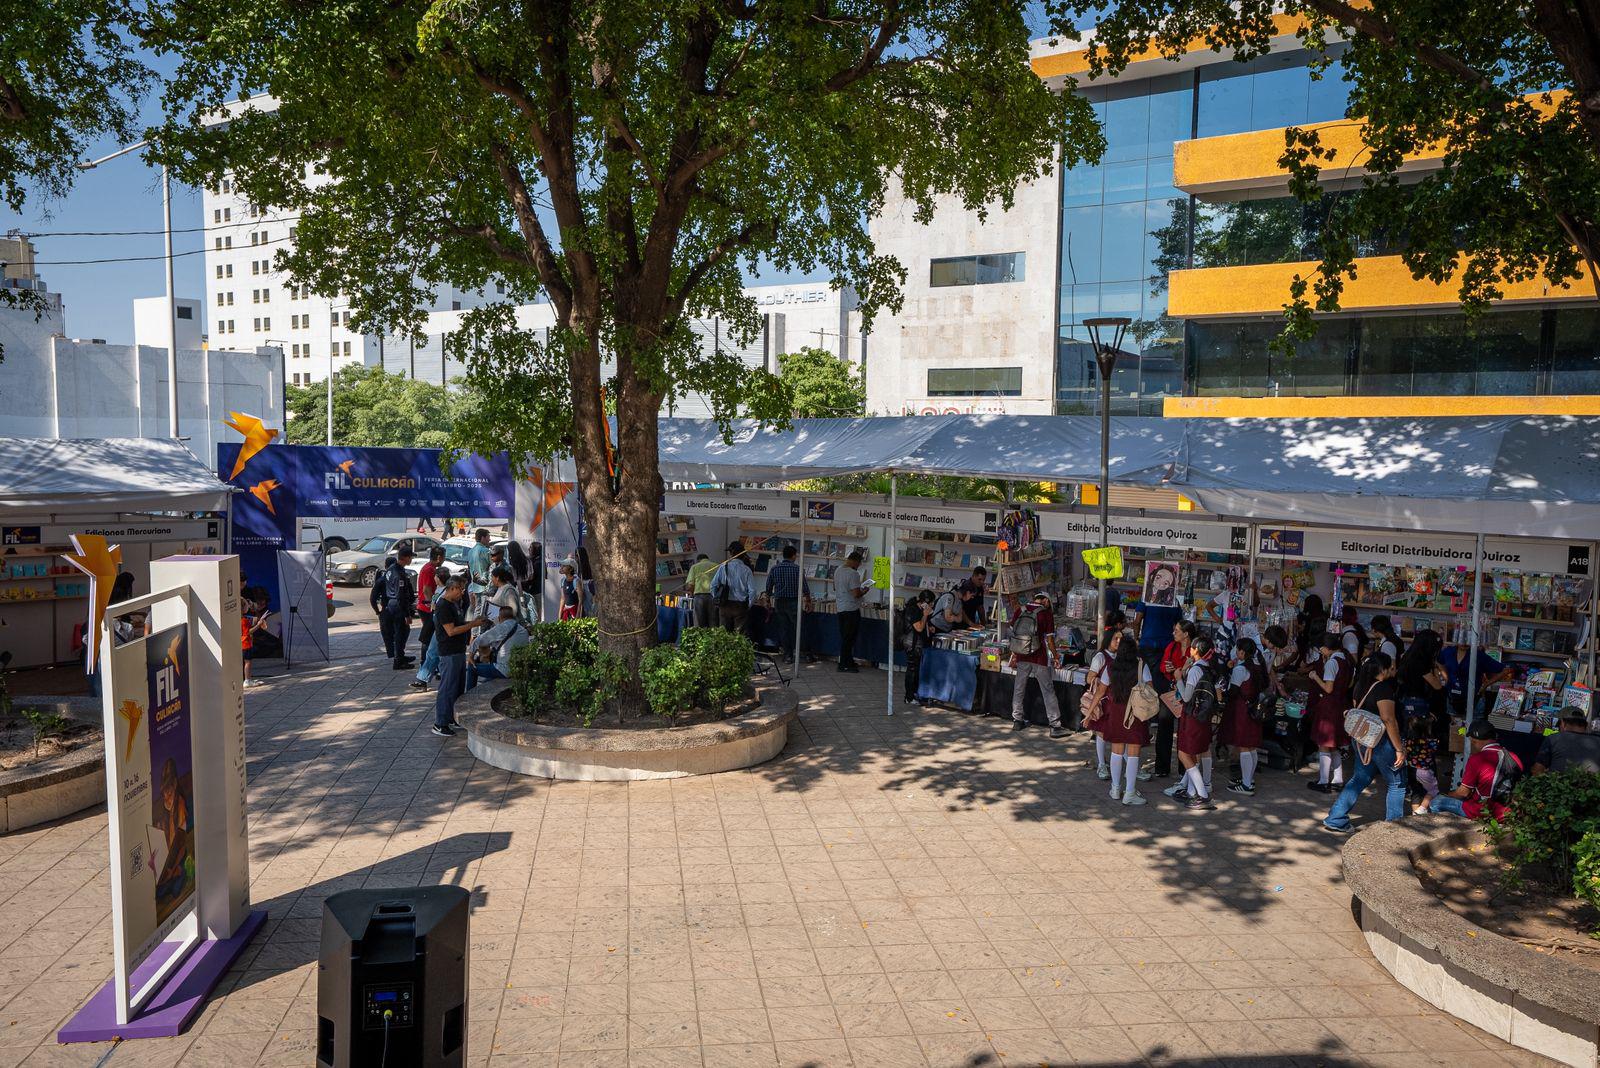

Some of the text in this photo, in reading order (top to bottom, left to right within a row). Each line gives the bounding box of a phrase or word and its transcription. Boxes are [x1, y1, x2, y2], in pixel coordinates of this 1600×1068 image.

[325, 472, 350, 490] FIL
[710, 501, 736, 509] Escalera
[888, 511, 918, 521] Ecalera
[1067, 522, 1100, 533] Editoria
[1166, 529, 1198, 540] Quiroz
[5, 534, 20, 544] FIL
[1261, 538, 1278, 551] FIL
[1341, 541, 1389, 554] Editorial
[1392, 544, 1473, 560] Distribuidora
[1570, 557, 1589, 566] A18
[156, 665, 180, 708] FIL
